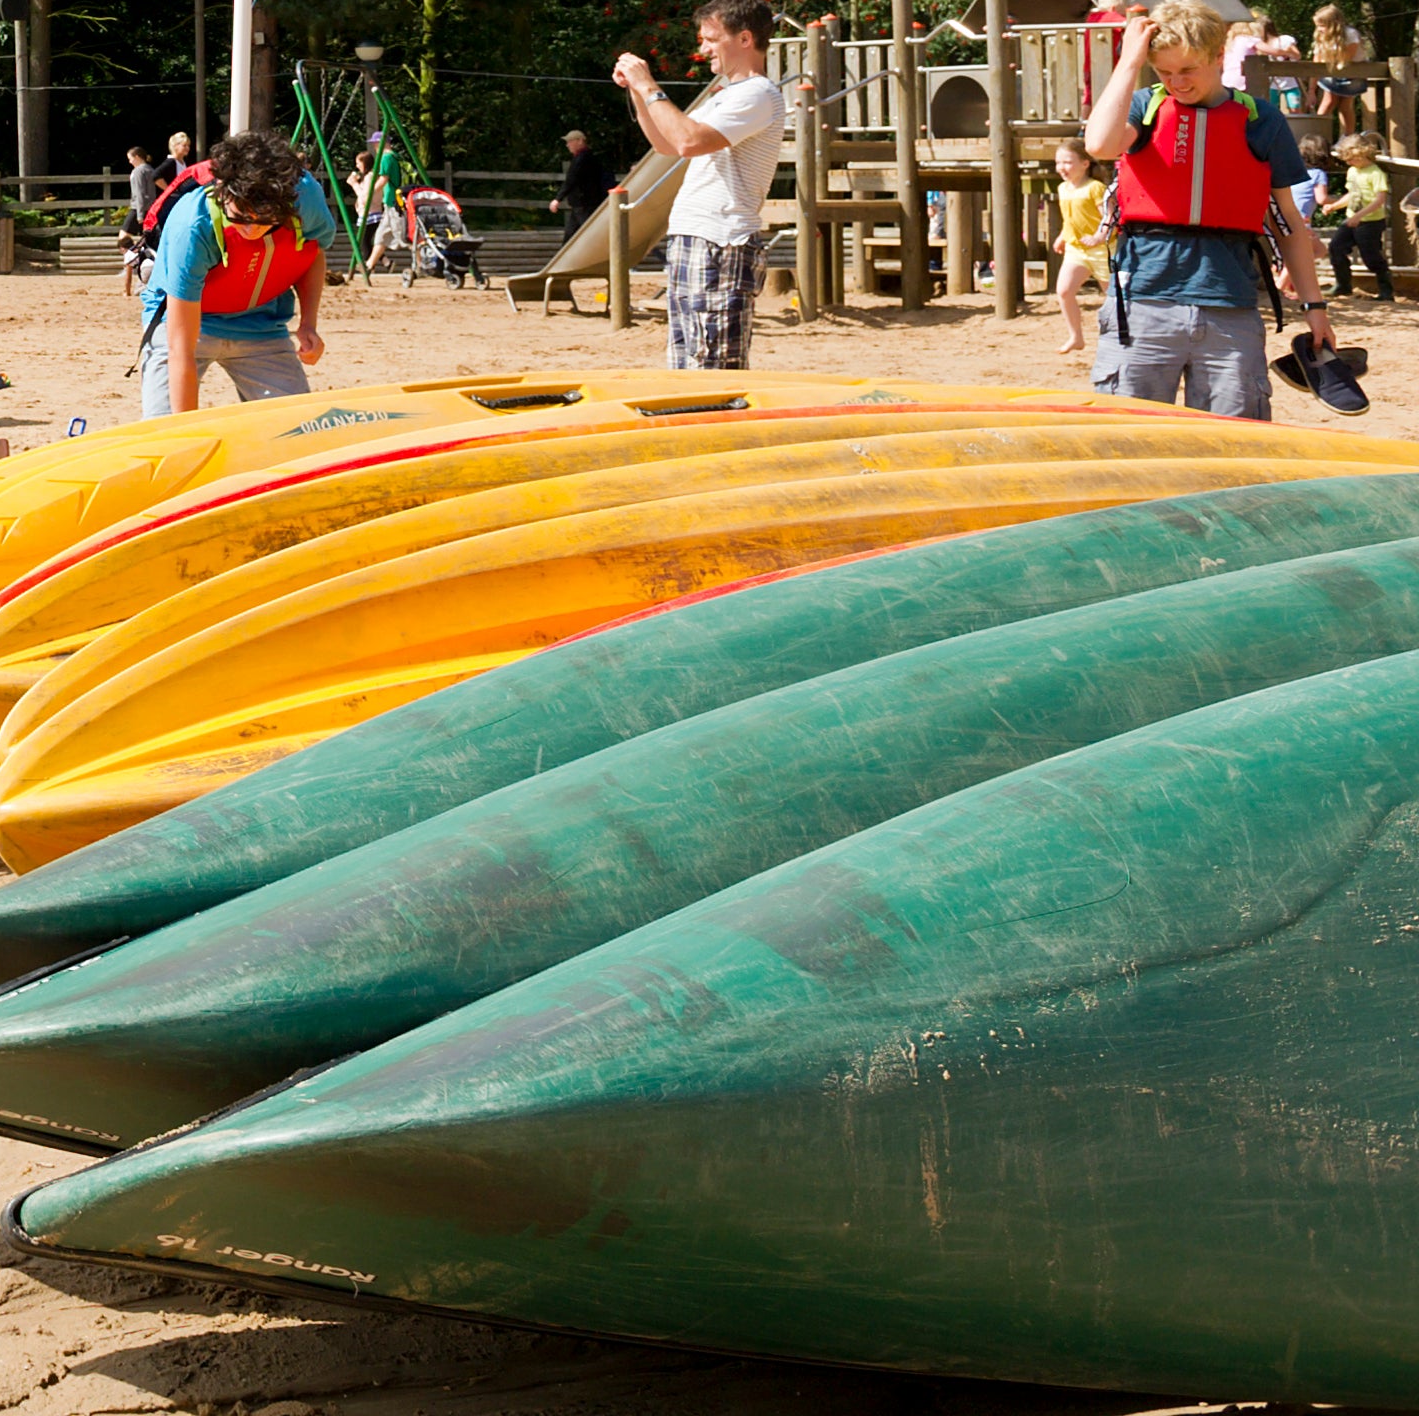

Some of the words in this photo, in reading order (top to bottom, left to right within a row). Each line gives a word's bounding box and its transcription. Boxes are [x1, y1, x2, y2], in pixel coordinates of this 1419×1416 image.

[300, 417, 332, 434] DUO
[333, 410, 389, 428] OCEAN
[156, 1234, 200, 1251] 16
[215, 1245, 379, 1284] Ranger
